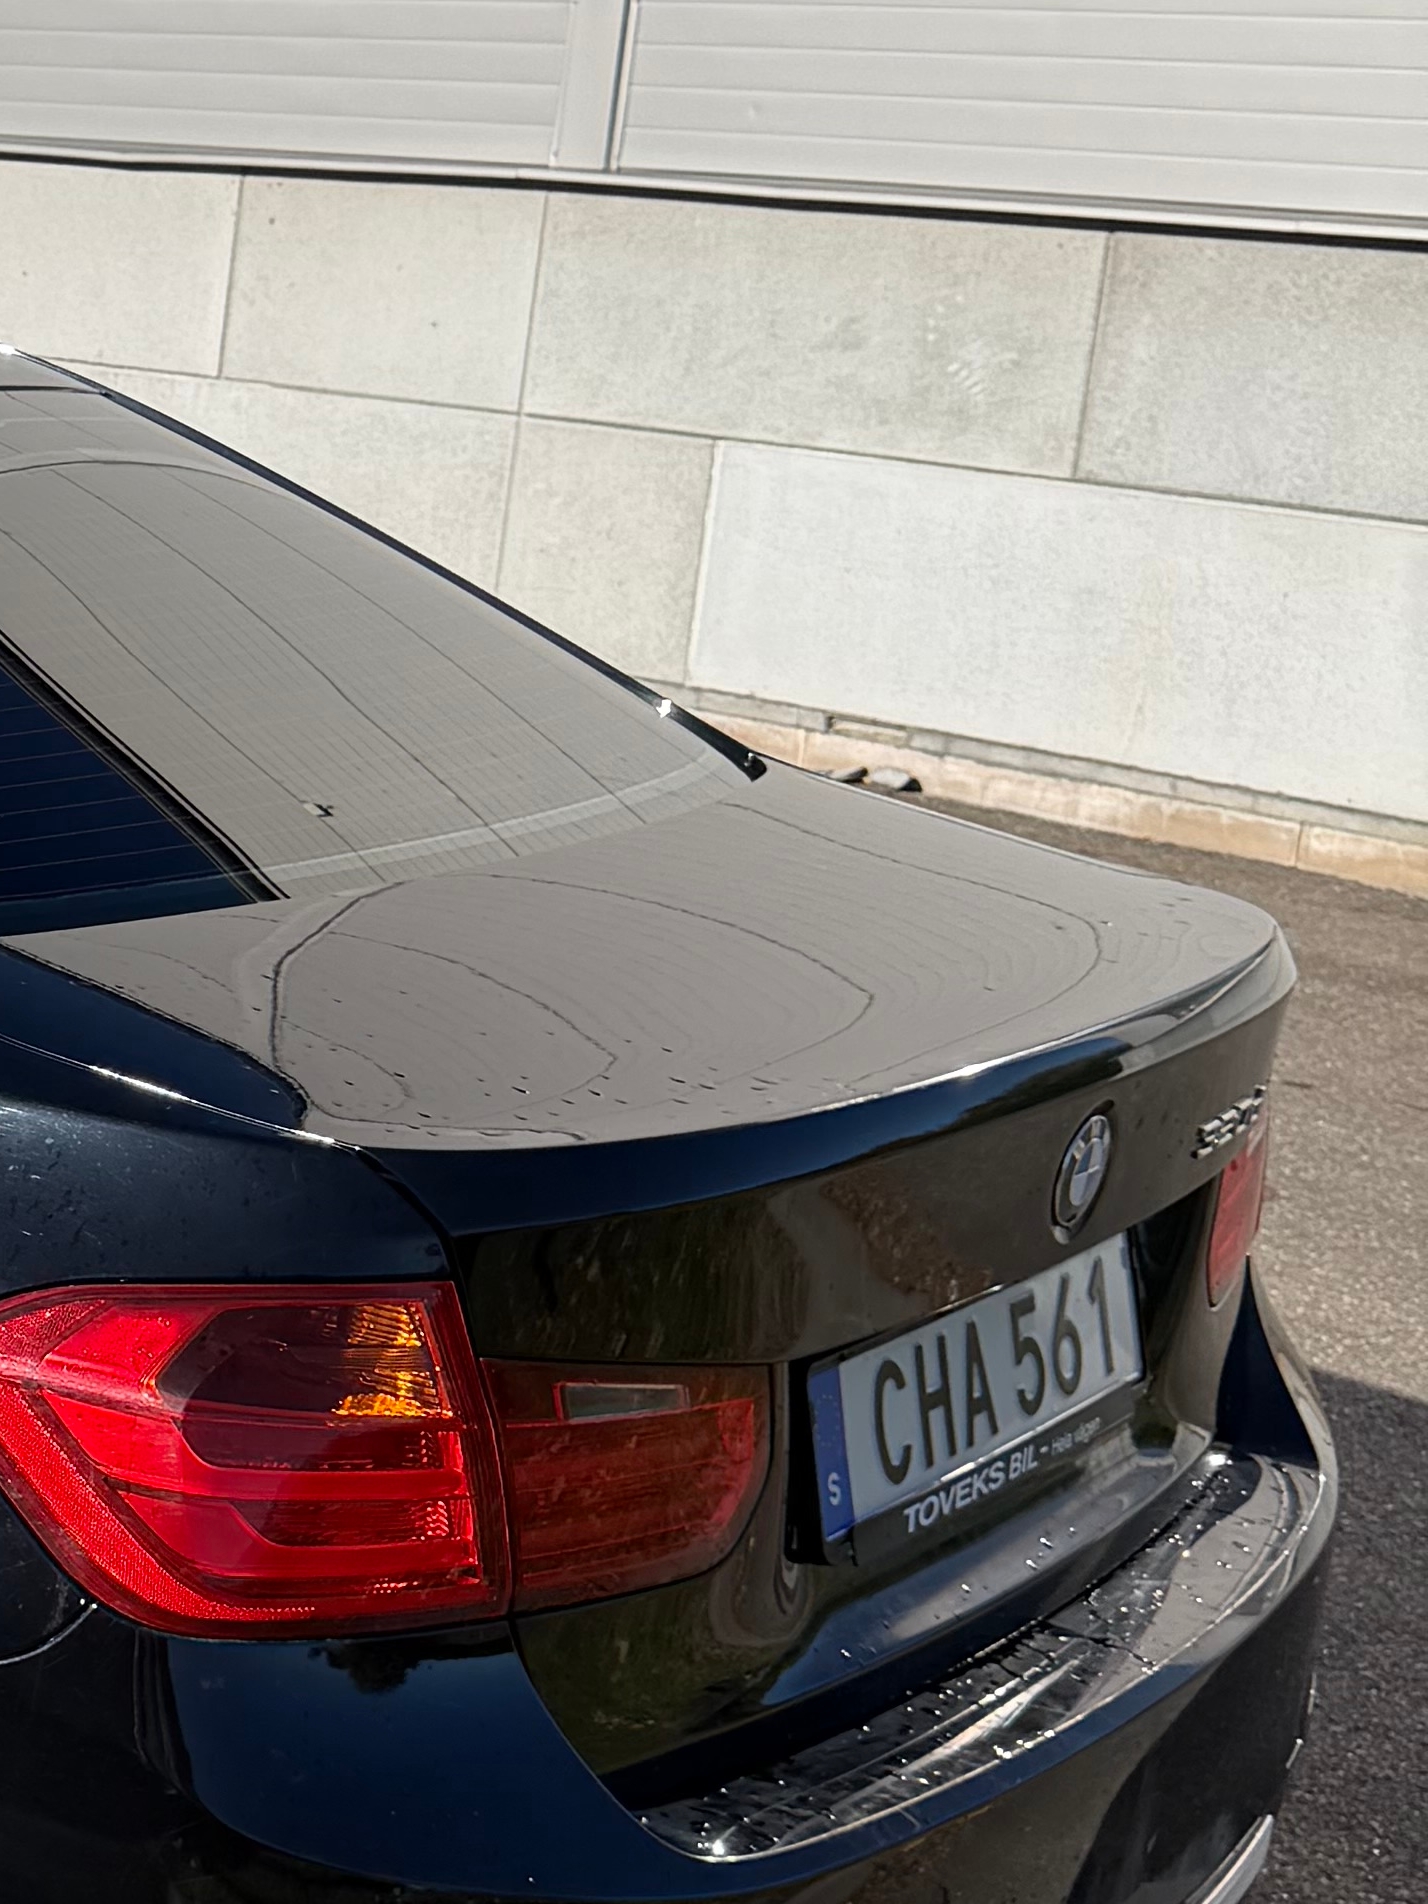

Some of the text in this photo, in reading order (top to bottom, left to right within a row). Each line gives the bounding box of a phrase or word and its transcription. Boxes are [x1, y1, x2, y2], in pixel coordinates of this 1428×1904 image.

[873, 1255, 1116, 1486] CHA 561
[827, 1472, 842, 1507] S
[902, 1457, 1008, 1534] TOVEKS
[1008, 1444, 1038, 1480] BIL
